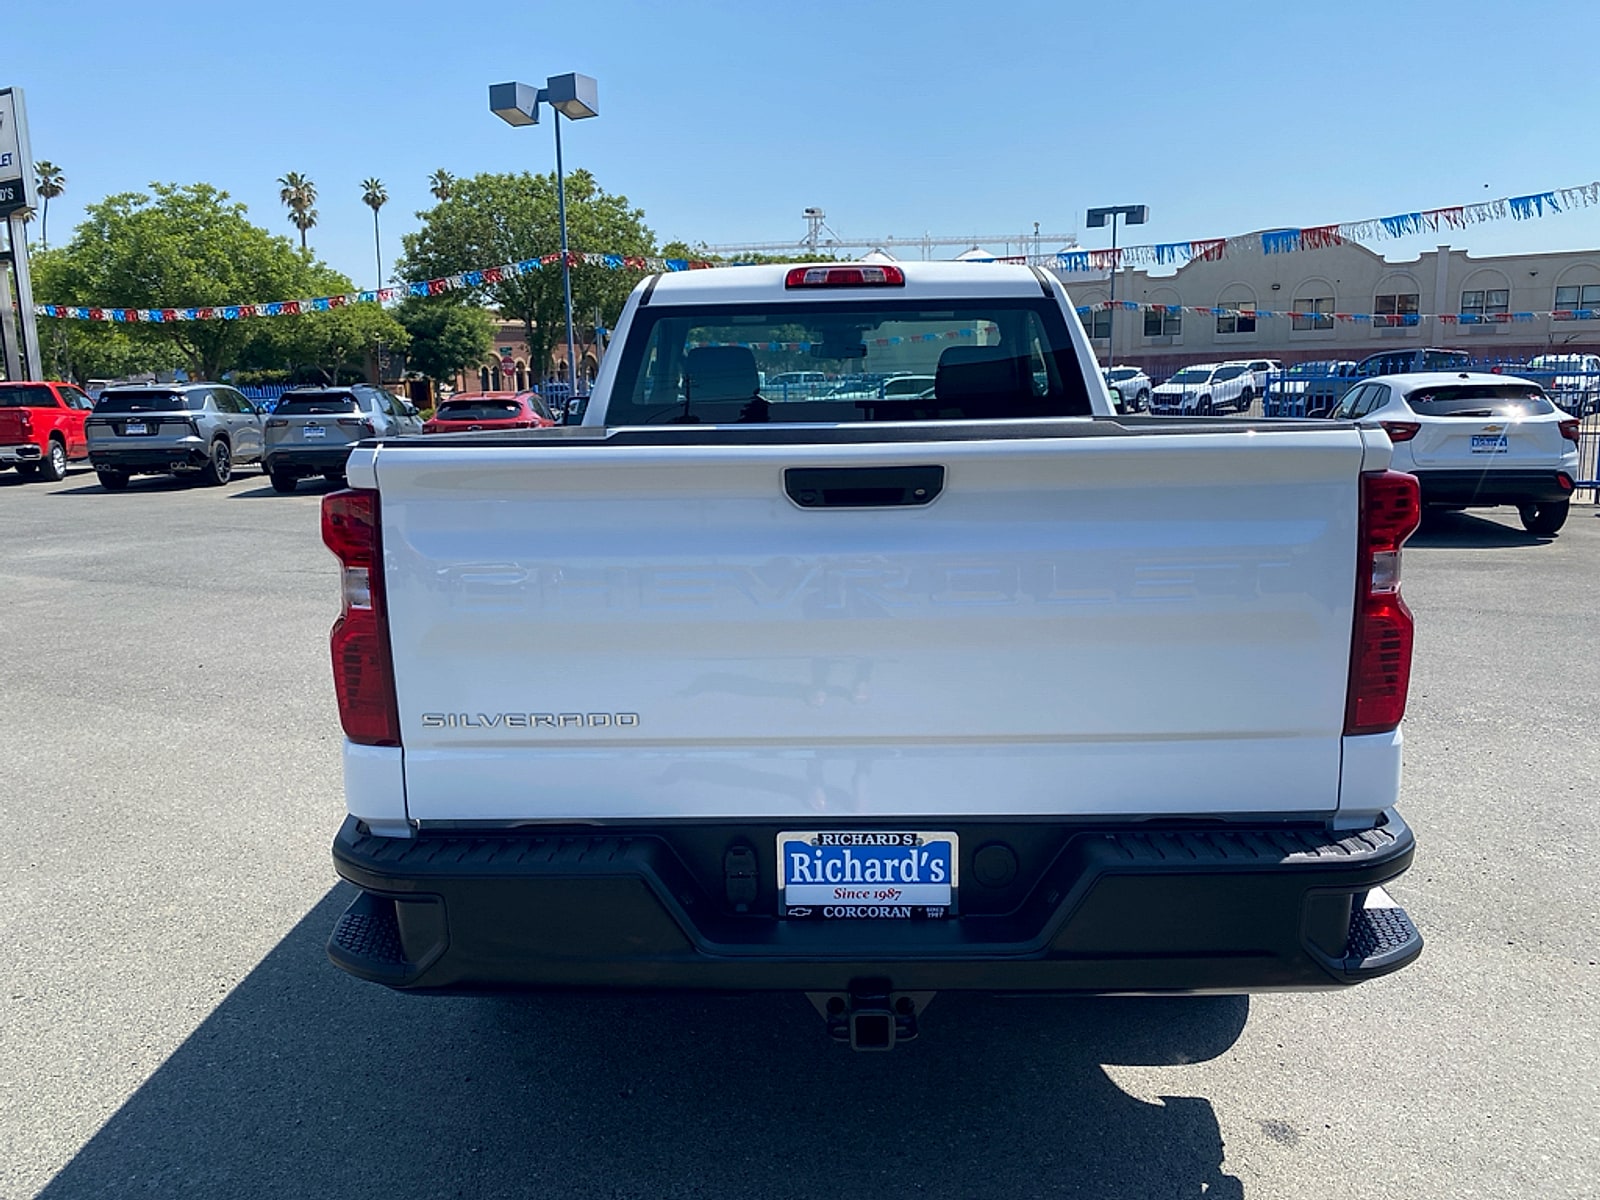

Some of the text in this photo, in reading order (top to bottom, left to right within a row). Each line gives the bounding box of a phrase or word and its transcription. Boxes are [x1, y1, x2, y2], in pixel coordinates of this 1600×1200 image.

[422, 713, 640, 728] SILVERADO
[790, 849, 945, 883] Richard's
[833, 888, 902, 901] Since 1987
[823, 906, 912, 918] CORCORAN
